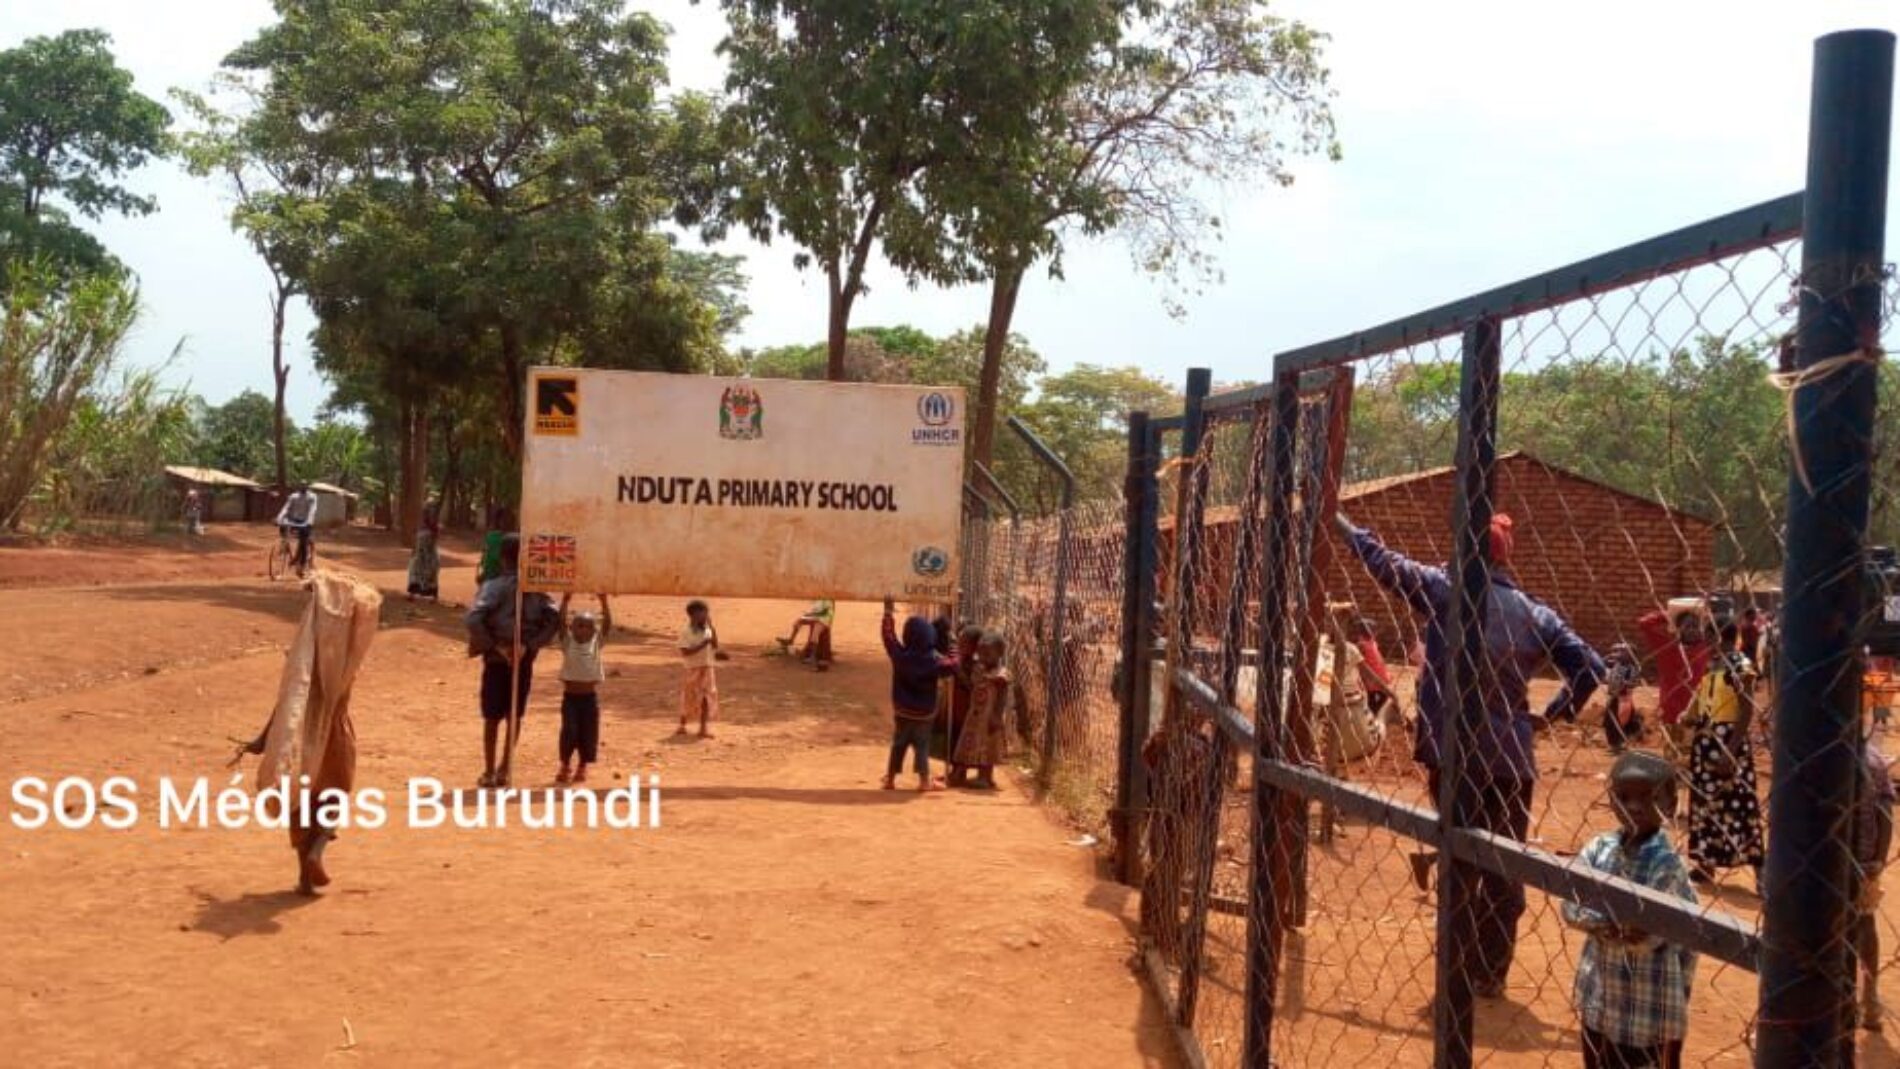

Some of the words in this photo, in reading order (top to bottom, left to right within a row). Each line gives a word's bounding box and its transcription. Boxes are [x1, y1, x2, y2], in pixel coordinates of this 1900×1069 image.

[912, 428, 959, 441] UNHCR
[617, 475, 713, 506] NDUTA
[717, 479, 814, 508] PRIMARY
[817, 482, 898, 512] SCHOOL
